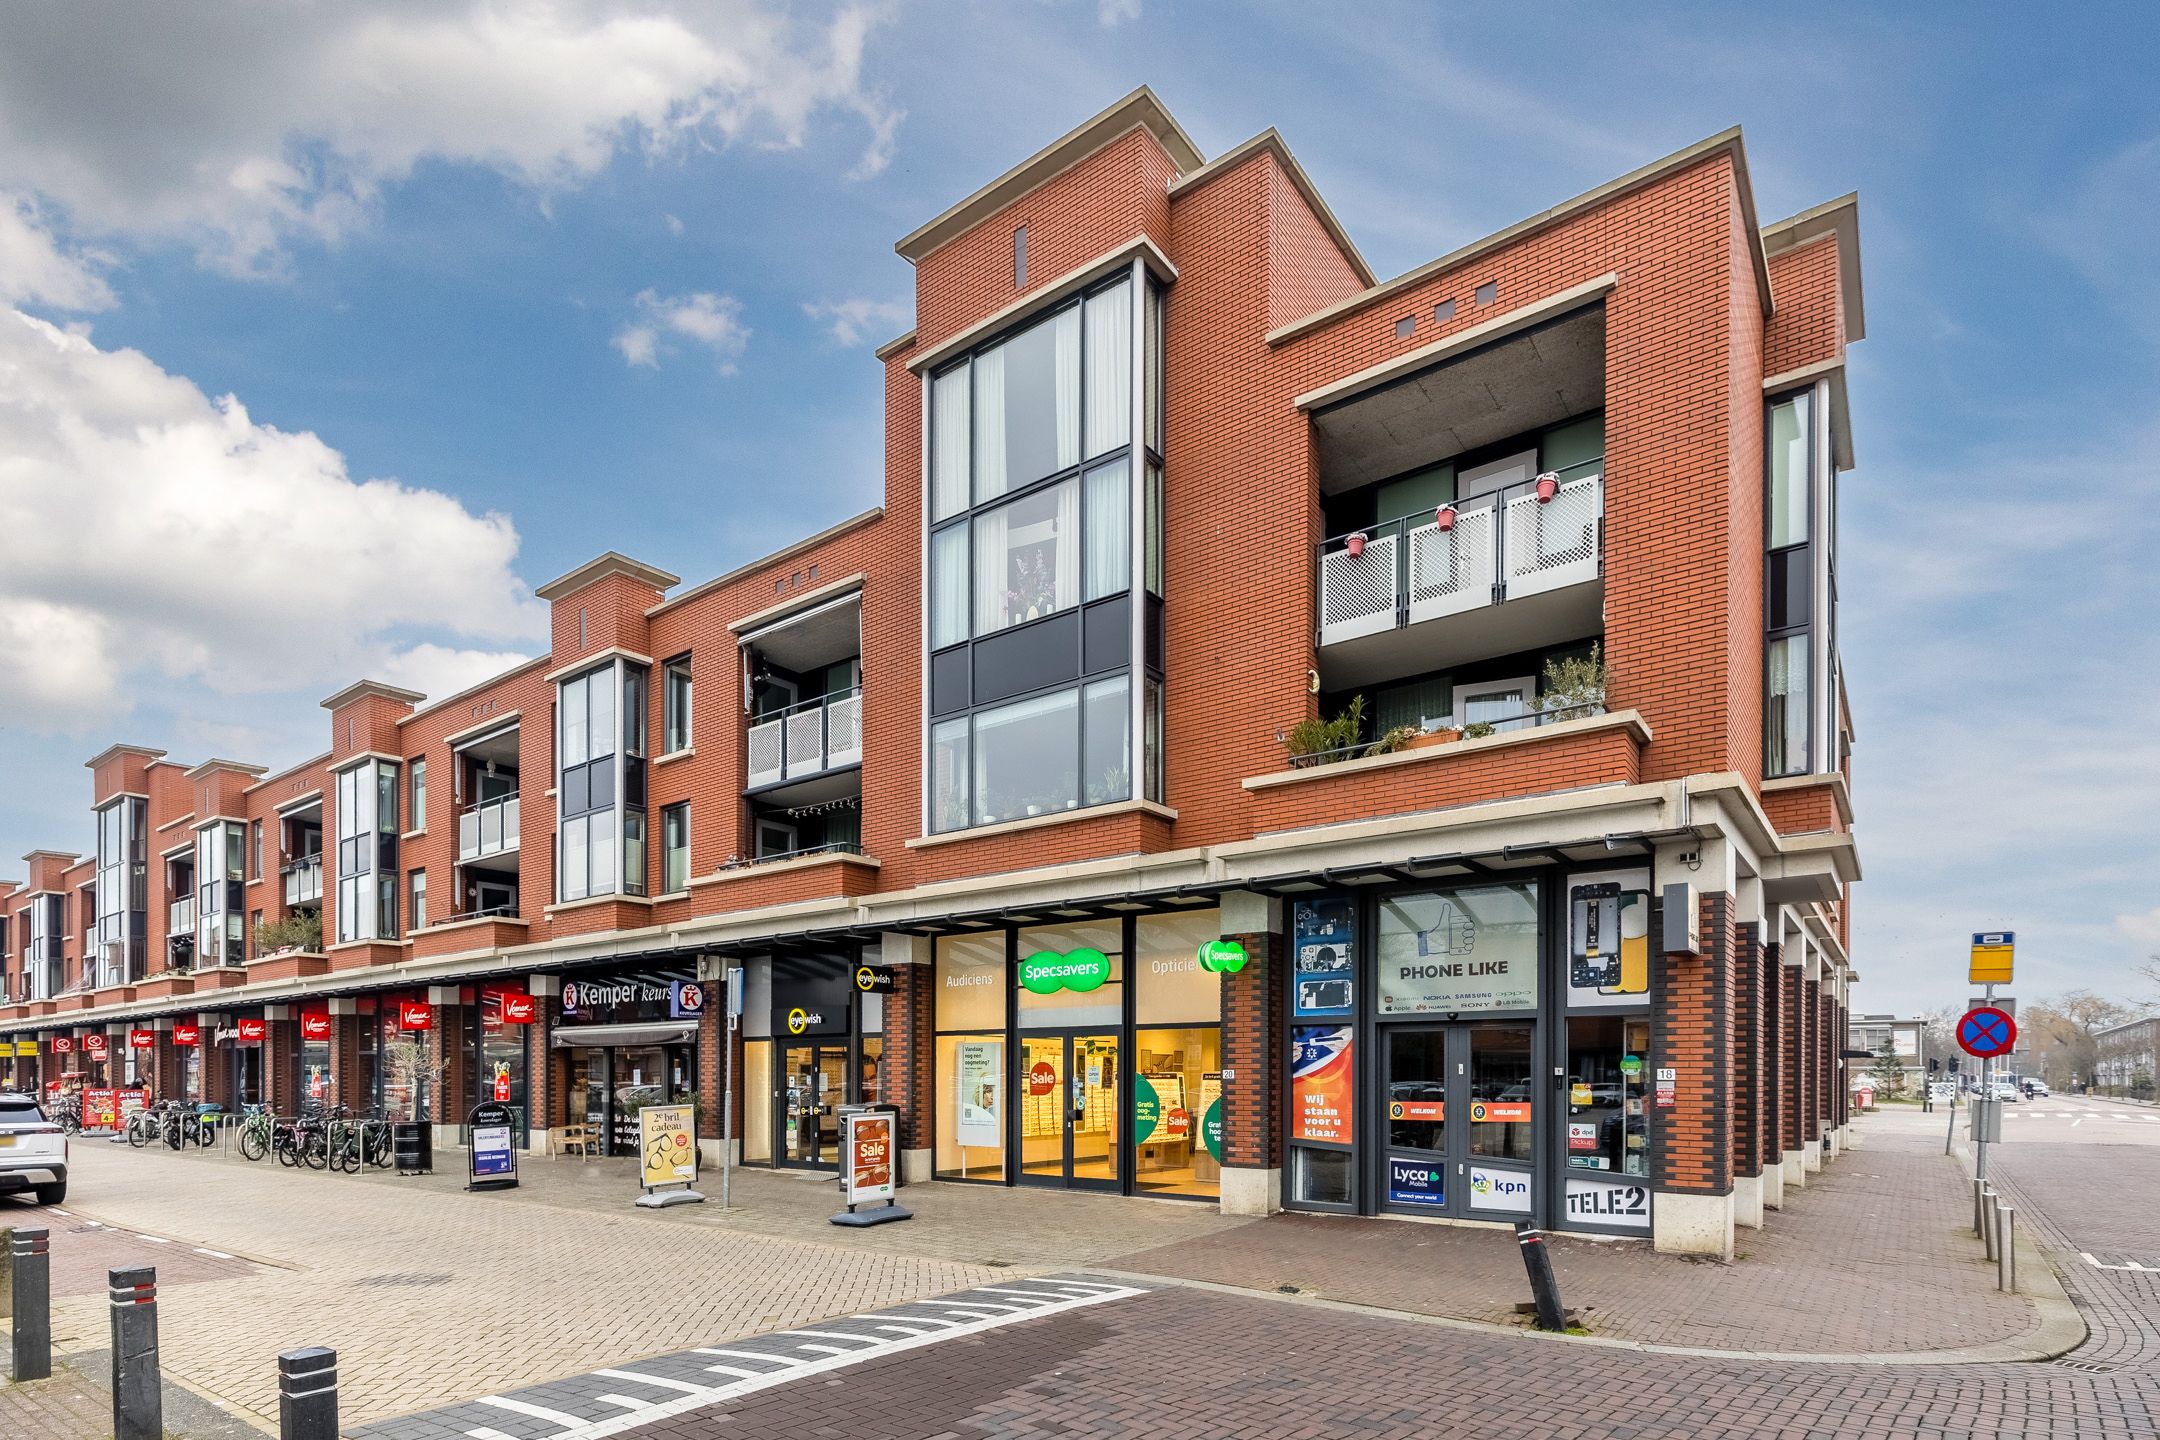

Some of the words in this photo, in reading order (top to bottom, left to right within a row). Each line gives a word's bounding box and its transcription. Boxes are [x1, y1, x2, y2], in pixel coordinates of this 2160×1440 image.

[1211, 950, 1243, 961] Specsavers
[1025, 963, 1099, 981] Specsavers
[1400, 964, 1463, 979] PHONE
[1468, 961, 1508, 976] LIKE
[946, 974, 993, 987] Audiciens
[580, 984, 637, 1009] Kemper
[683, 991, 698, 1006] K
[1031, 1072, 1054, 1084] Sale
[1660, 1070, 1673, 1079] 18
[1304, 1095, 1324, 1105] Wij
[664, 1112, 680, 1122] bril
[1304, 1108, 1338, 1116] staan
[651, 1123, 682, 1132] cadeau
[1168, 1117, 1188, 1126] Sale
[1304, 1128, 1339, 1137] klaar.
[1570, 1138, 1593, 1146] Pickup
[860, 1142, 885, 1158] Sale
[1394, 1166, 1428, 1182] Lyca
[1495, 1179, 1526, 1194] kpn
[1567, 1187, 1646, 1215] TELE2
